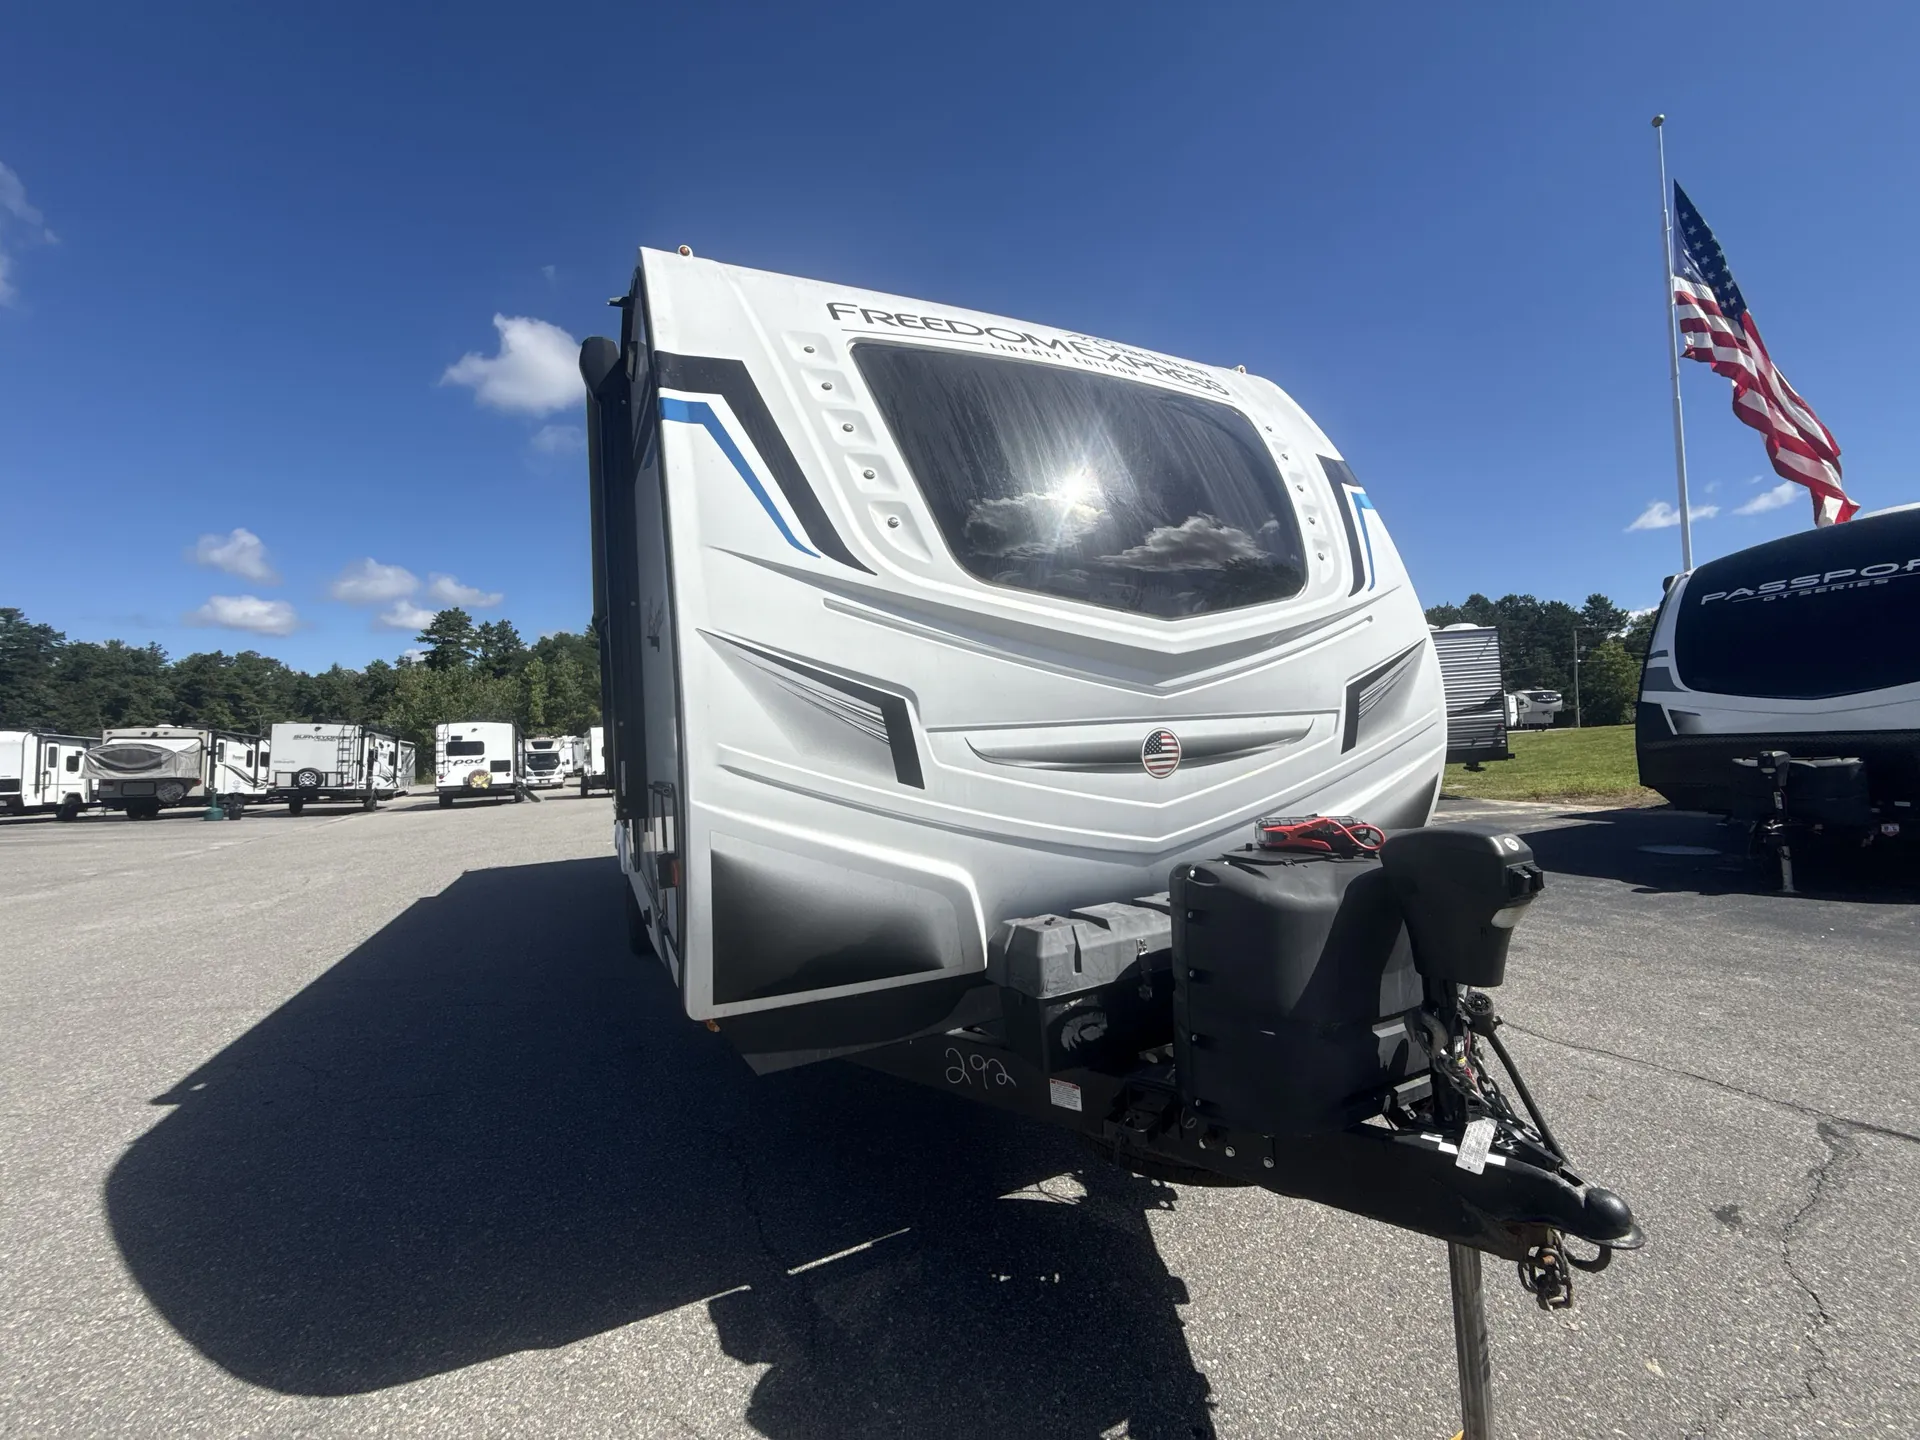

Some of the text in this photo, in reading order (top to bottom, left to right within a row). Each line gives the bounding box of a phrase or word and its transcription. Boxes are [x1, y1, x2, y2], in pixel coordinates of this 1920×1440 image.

[989, 342, 1138, 376] LIBERTY EDITION
[1798, 578, 1889, 596] SERIES
[945, 1047, 1017, 1090] 292
